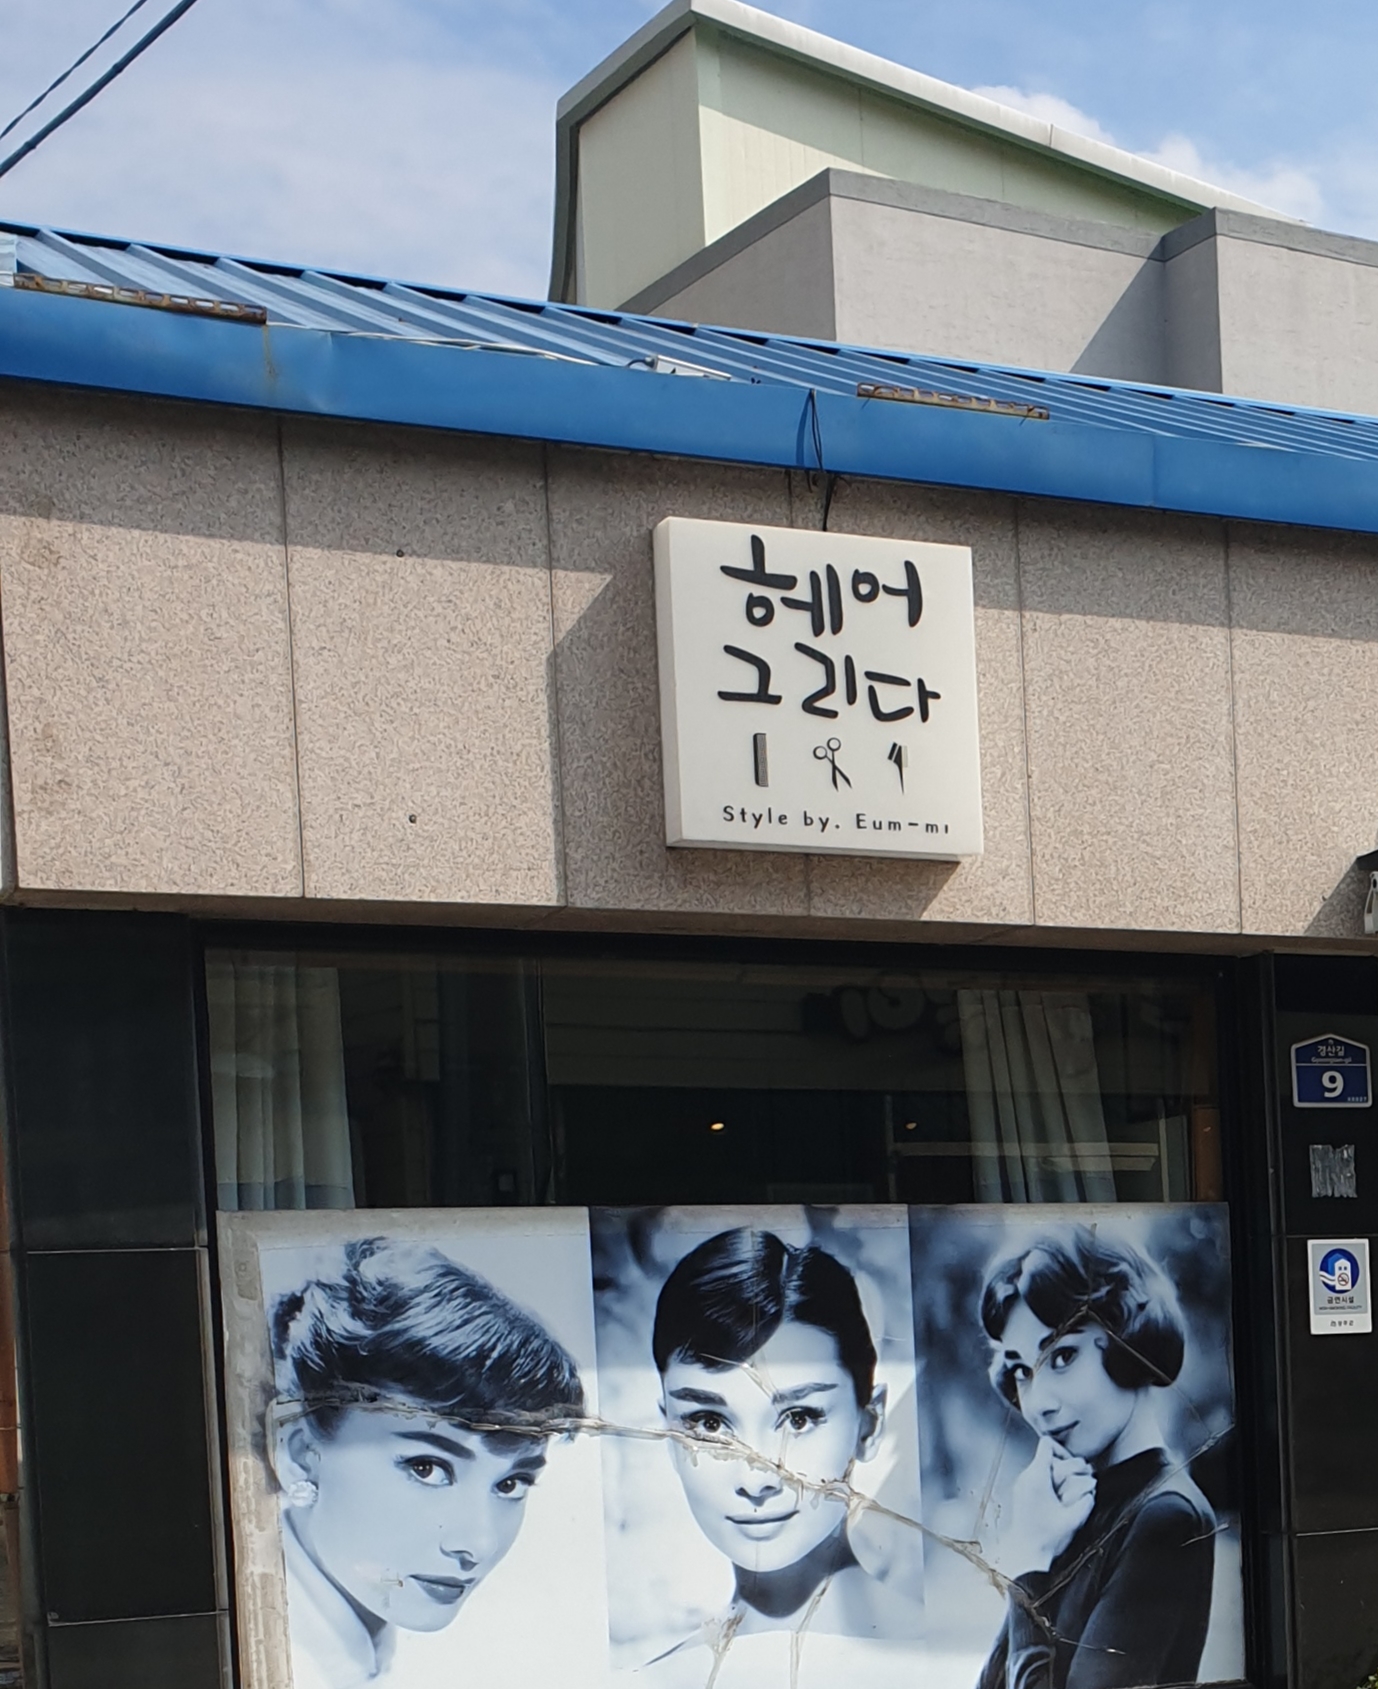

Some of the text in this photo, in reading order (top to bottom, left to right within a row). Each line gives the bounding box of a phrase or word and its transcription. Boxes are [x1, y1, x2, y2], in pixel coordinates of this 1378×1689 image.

[719, 534, 924, 638] 헤어
[717, 642, 942, 723] 그리다
[722, 806, 789, 829] Style
[804, 811, 841, 833] by.
[1321, 1071, 1344, 1098] 9
